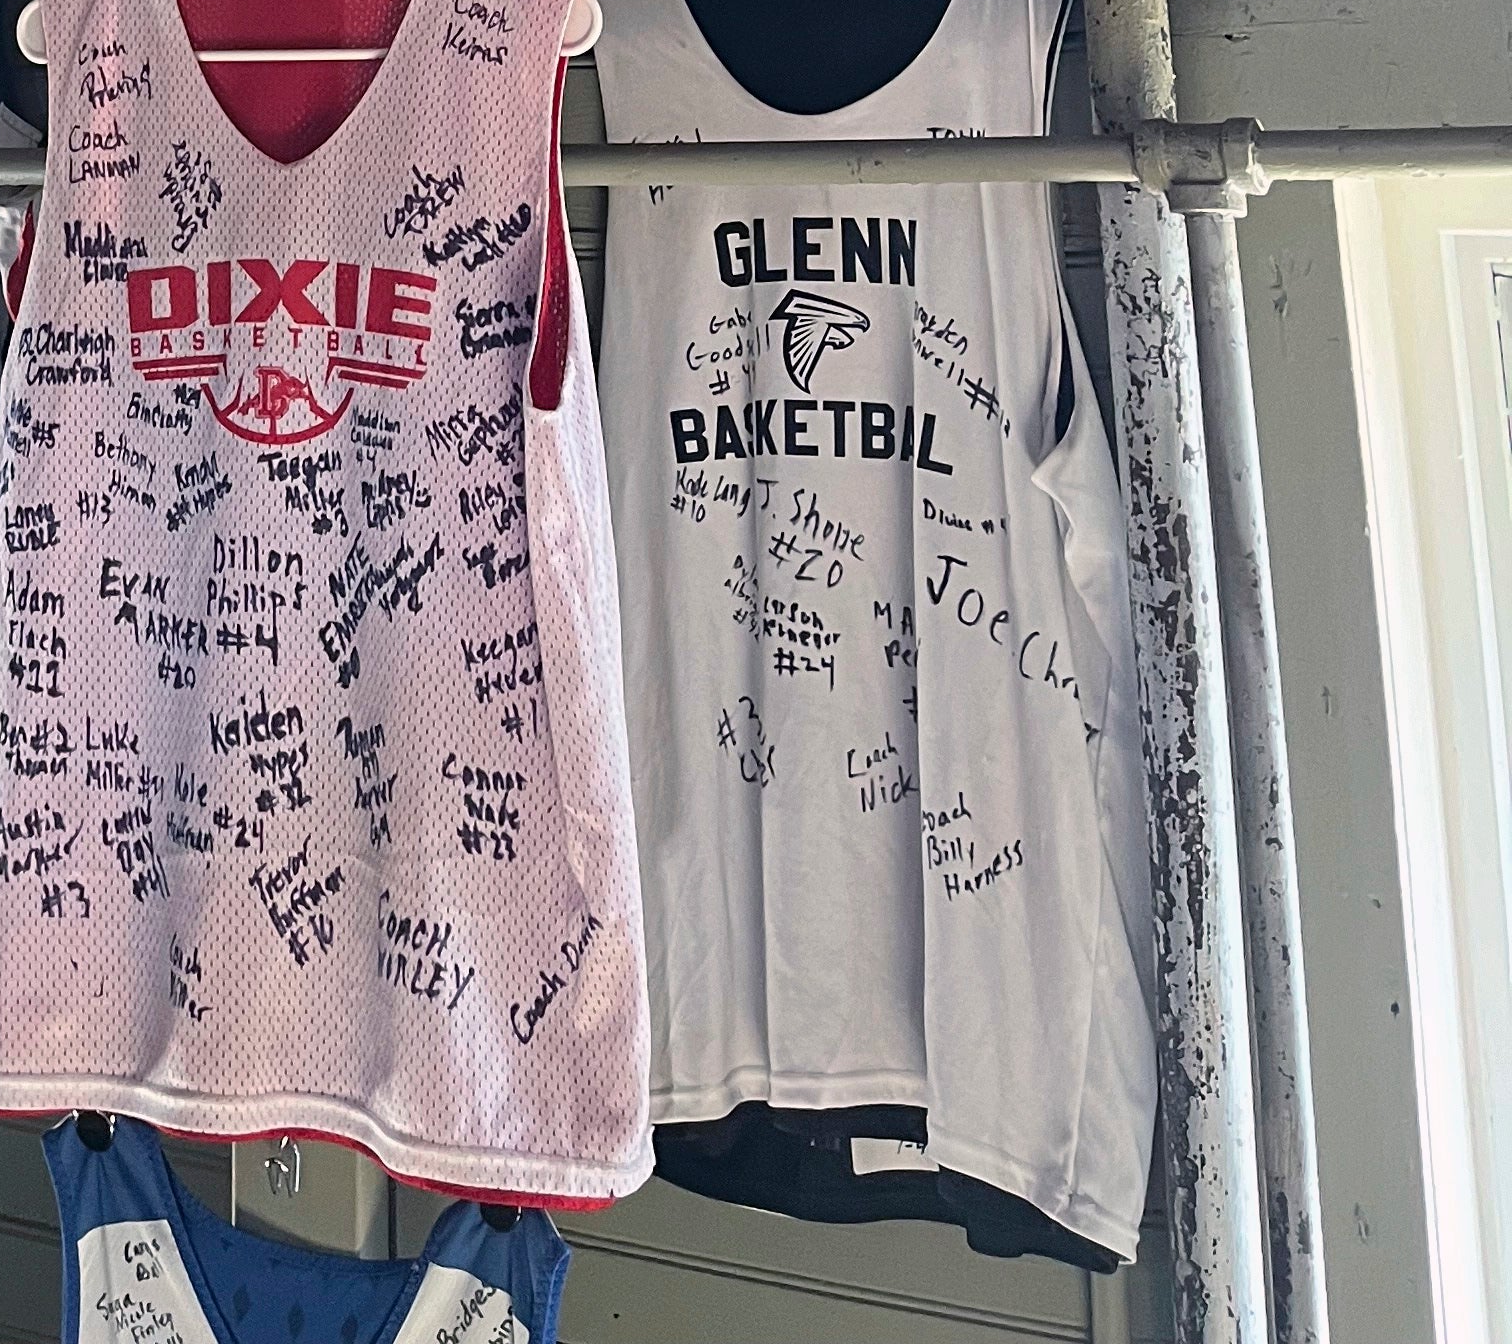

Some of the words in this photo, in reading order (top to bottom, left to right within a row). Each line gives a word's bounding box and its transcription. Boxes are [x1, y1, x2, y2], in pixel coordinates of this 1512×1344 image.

[69, 121, 128, 153] Coach
[69, 152, 140, 184] LANMAN
[714, 217, 917, 287] GLENN
[126, 258, 438, 343] DIXIE
[130, 325, 429, 367] BASKETBALL
[26, 357, 113, 388] Crawford
[32, 422, 60, 449] #5
[671, 494, 706, 523] #10
[213, 533, 304, 578] Dillon
[769, 532, 844, 588] #20
[6, 569, 65, 614] Adam
[206, 578, 308, 632] Phillips
[114, 602, 209, 657] PARKER
[217, 622, 281, 667] #4
[773, 647, 835, 692] #24
[86, 715, 140, 756] Luke
[442, 753, 527, 793] Connor
[861, 766, 919, 813] Nick
[213, 805, 265, 854] #24
[926, 836, 976, 870] Billy
[943, 839, 1023, 901] Harness
[41, 880, 90, 919] #3
[509, 970, 568, 1045] Coach
